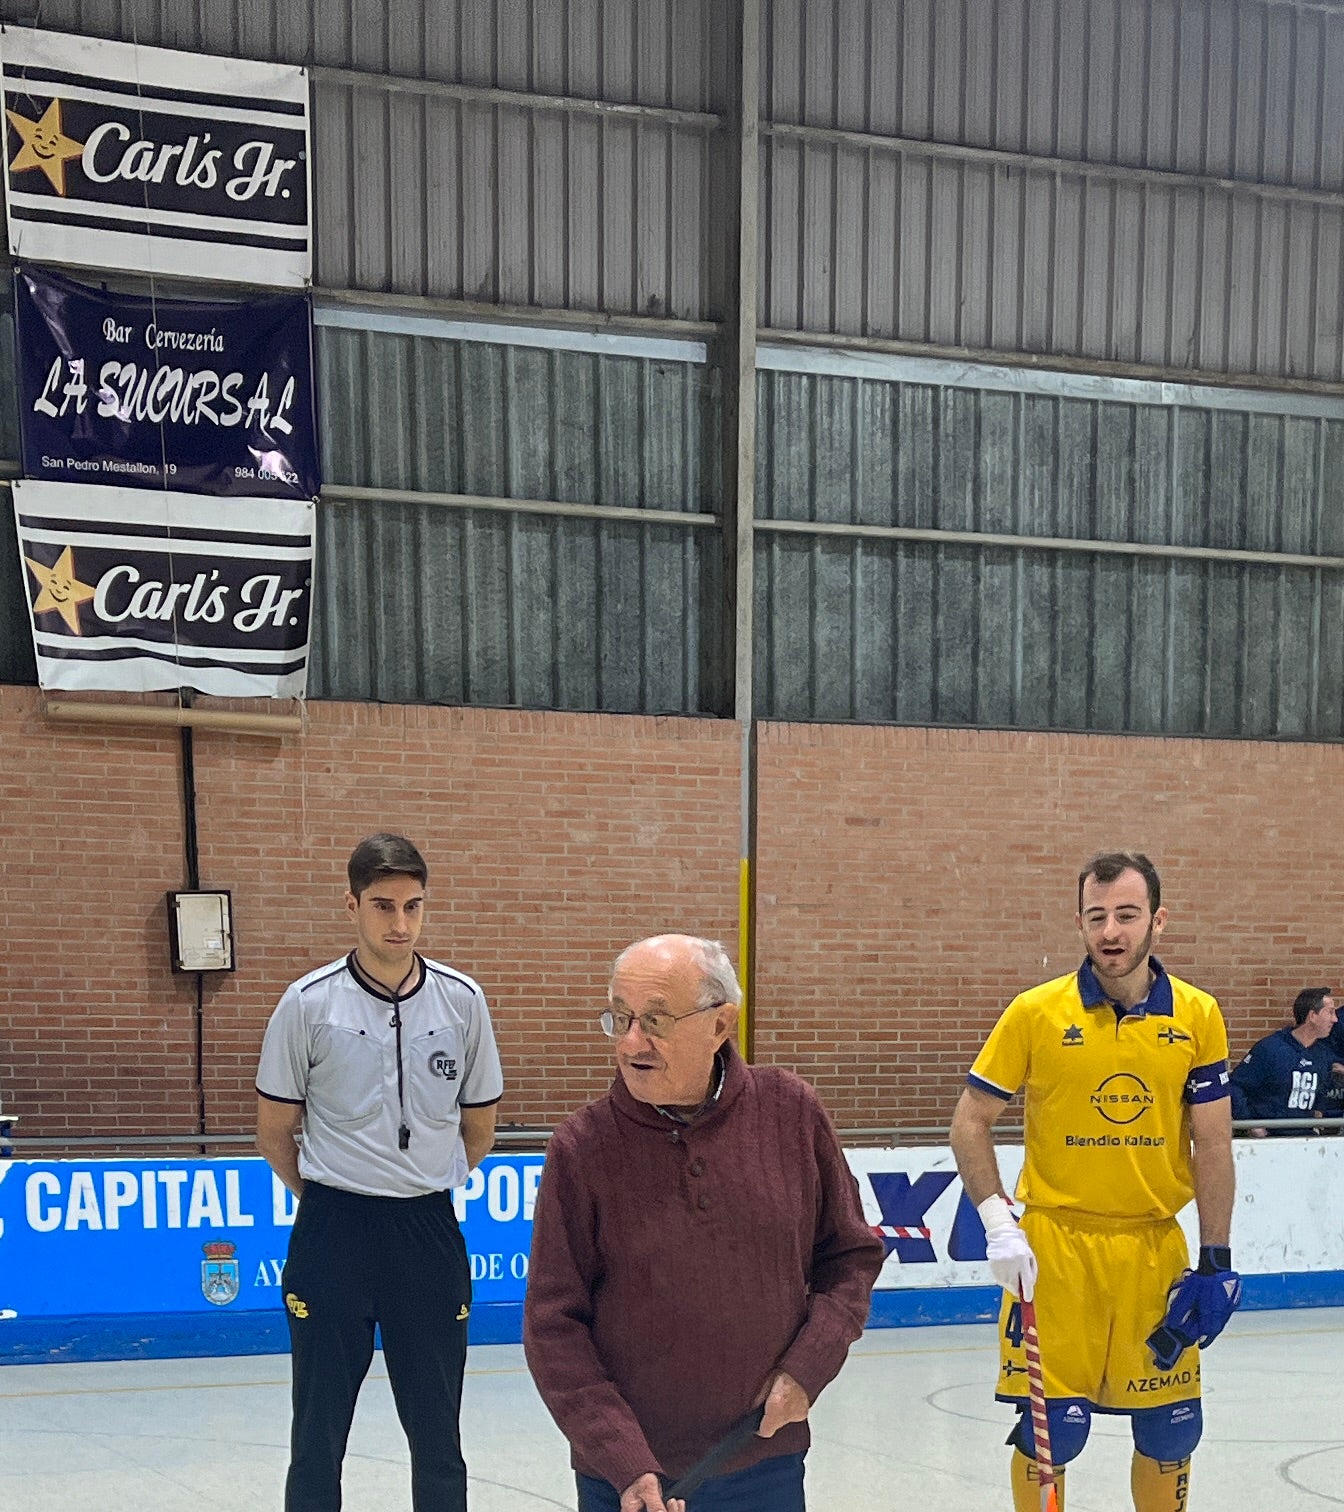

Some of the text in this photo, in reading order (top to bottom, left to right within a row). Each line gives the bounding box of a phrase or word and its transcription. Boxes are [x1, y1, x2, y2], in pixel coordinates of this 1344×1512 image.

[82, 122, 296, 200] Carl's Jr.
[103, 318, 224, 352] Bar Cervezería
[34, 356, 295, 435] LA SUCURSAL
[42, 456, 63, 468] San
[67, 458, 100, 471] Pedro
[235, 467, 254, 478] 984
[93, 566, 303, 633] Carl's Jr.
[1090, 1094, 1154, 1104] NISSAN
[1066, 1135, 1120, 1146] Blendio
[25, 1169, 254, 1232] CAPITAL
[1126, 1371, 1191, 1392] AZEMAD
